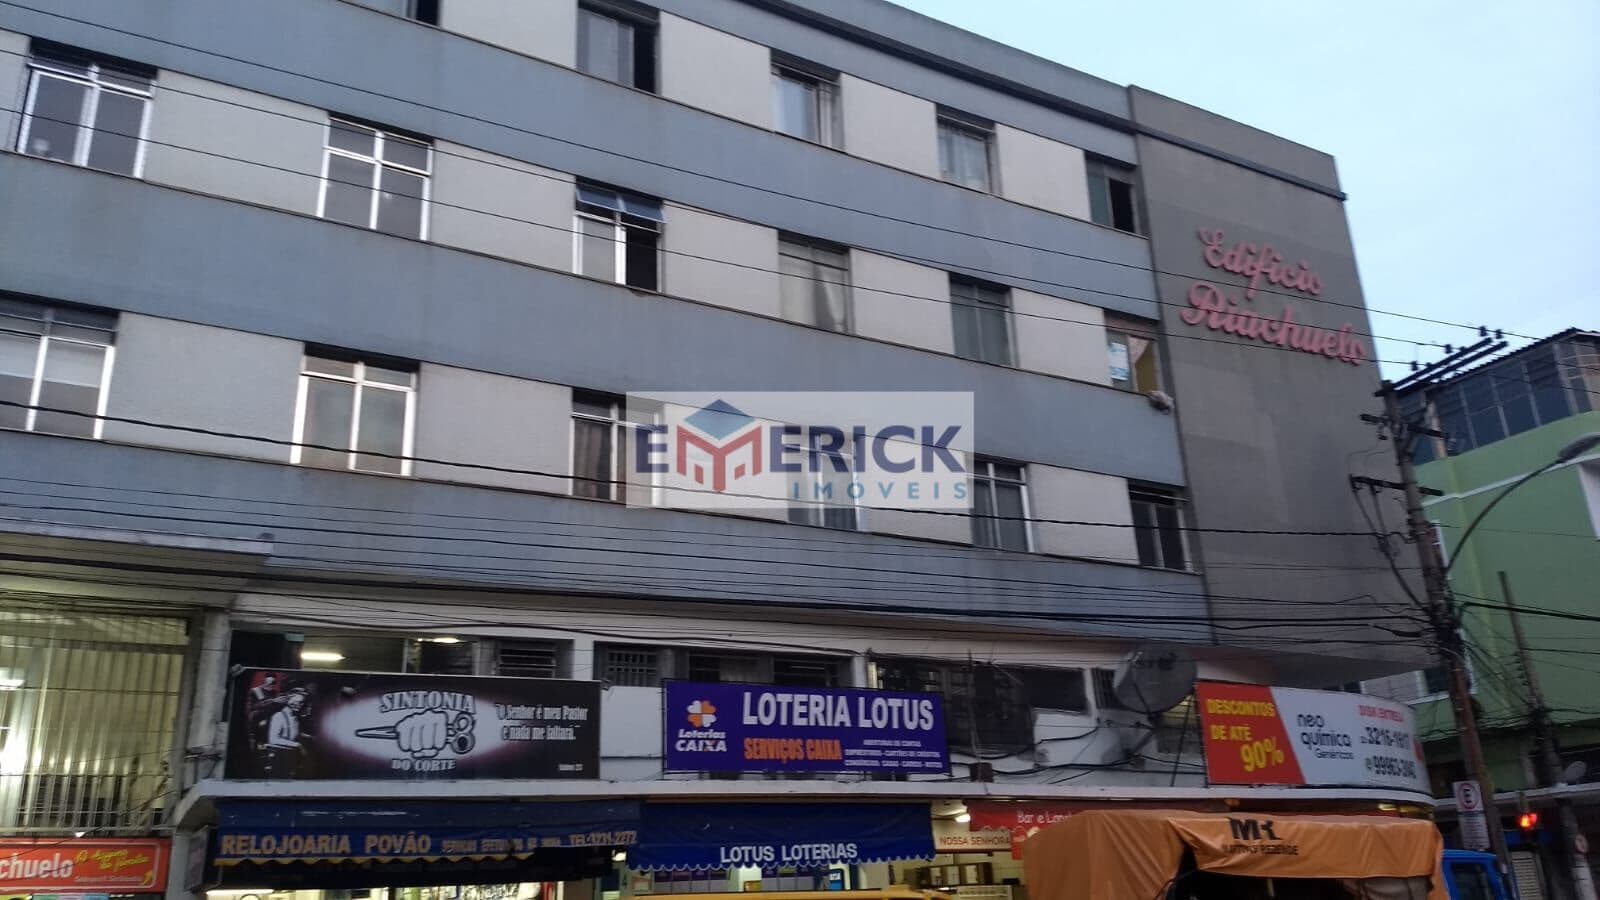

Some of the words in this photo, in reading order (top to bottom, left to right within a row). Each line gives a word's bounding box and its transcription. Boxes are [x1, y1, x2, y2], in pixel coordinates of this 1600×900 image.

[1179, 281, 1366, 365] Riachuelo
[380, 690, 476, 714] SINTONIA
[743, 692, 852, 727] LOTERIA
[858, 696, 935, 731] LOTUS
[1207, 698, 1276, 718] DESCONTOS
[1297, 713, 1325, 728] neo
[678, 729, 727, 739] Loterias
[1210, 724, 1227, 741] DE
[1229, 722, 1253, 742] ATÉ
[1300, 729, 1353, 750] química
[675, 740, 728, 752] CAIXA
[743, 737, 805, 763] SERVIÇOS
[806, 738, 842, 760] CAIXA
[1240, 736, 1285, 773] 90%
[391, 759, 411, 770] DO
[415, 759, 457, 772] CORTE
[221, 834, 351, 855] RELOJOARIA
[365, 831, 432, 854] POVÃO
[940, 836, 968, 845] NOSSA
[720, 845, 776, 864] LOTUS
[781, 843, 859, 862] LOTERIAS
[0, 852, 75, 880] chuelo
